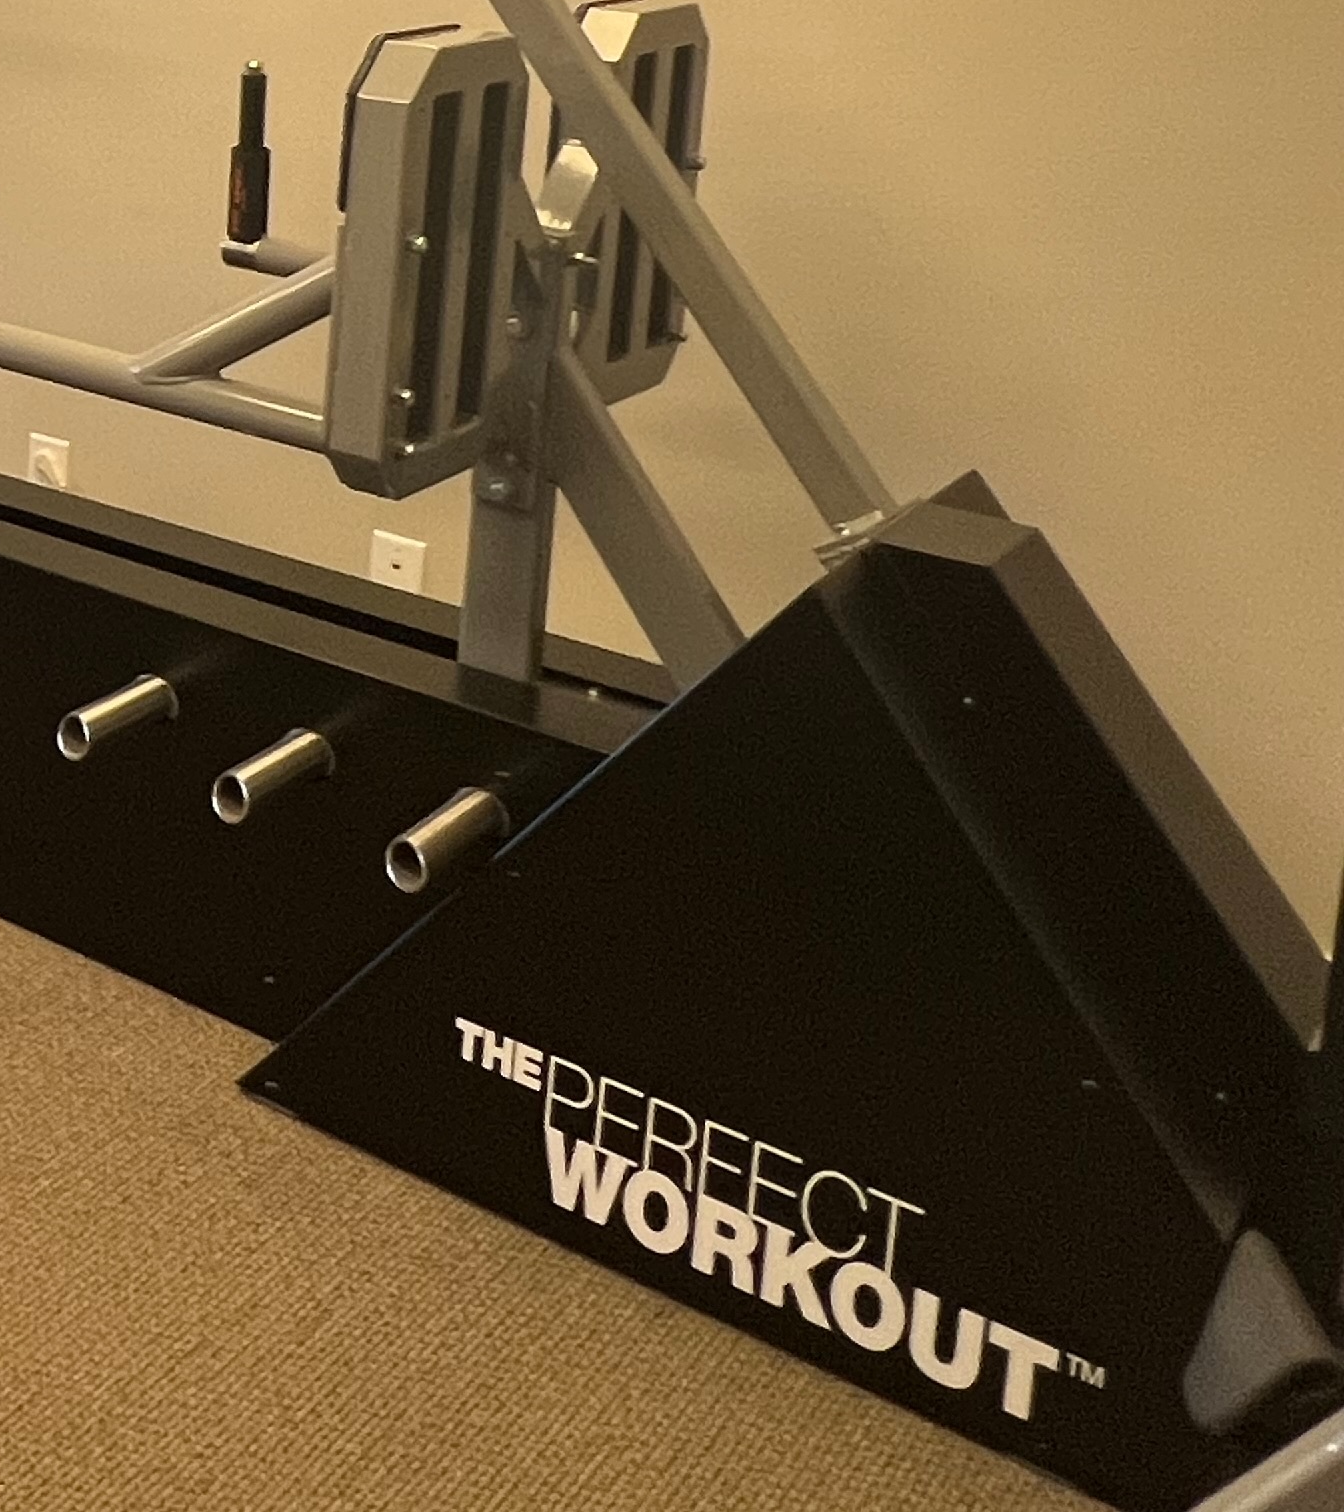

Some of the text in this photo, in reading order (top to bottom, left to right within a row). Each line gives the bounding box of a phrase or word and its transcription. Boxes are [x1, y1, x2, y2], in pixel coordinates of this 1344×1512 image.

[454, 1016, 927, 1281] THE PERFECT
[543, 1125, 1060, 1422] WORKOUT
